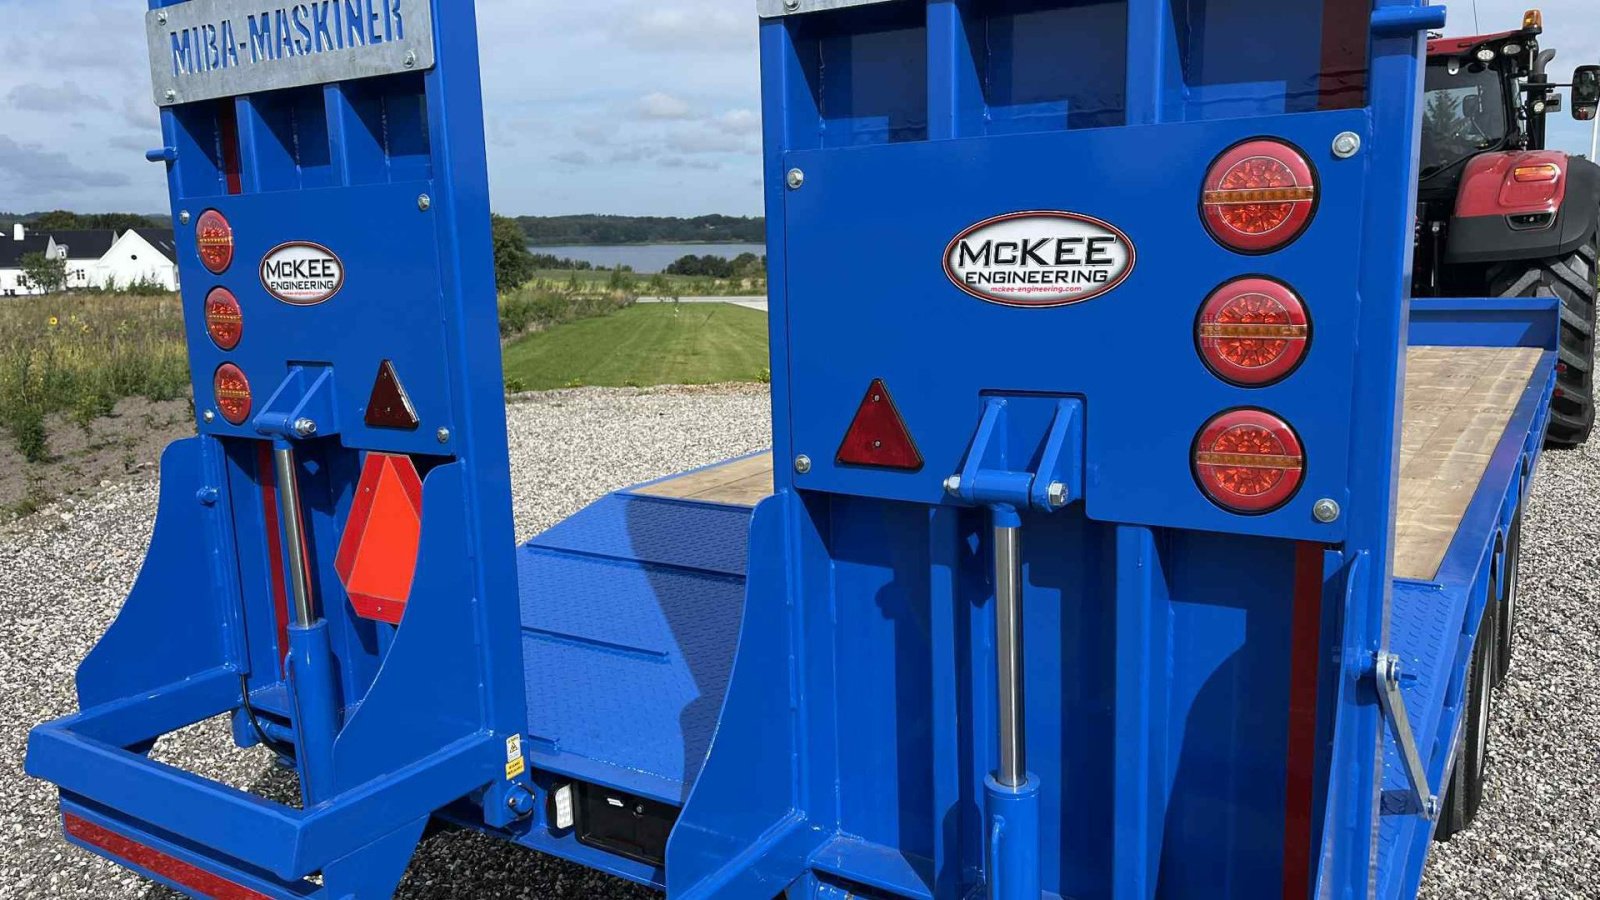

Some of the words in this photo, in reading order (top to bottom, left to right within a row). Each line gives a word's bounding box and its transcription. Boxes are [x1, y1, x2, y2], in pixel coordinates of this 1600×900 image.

[169, 0, 404, 77] MIBA-MASKINER
[965, 270, 1108, 285] ENGINEERING
[270, 281, 334, 290] ENGINEERING
[990, 285, 1082, 294] mckee-engineering.com
